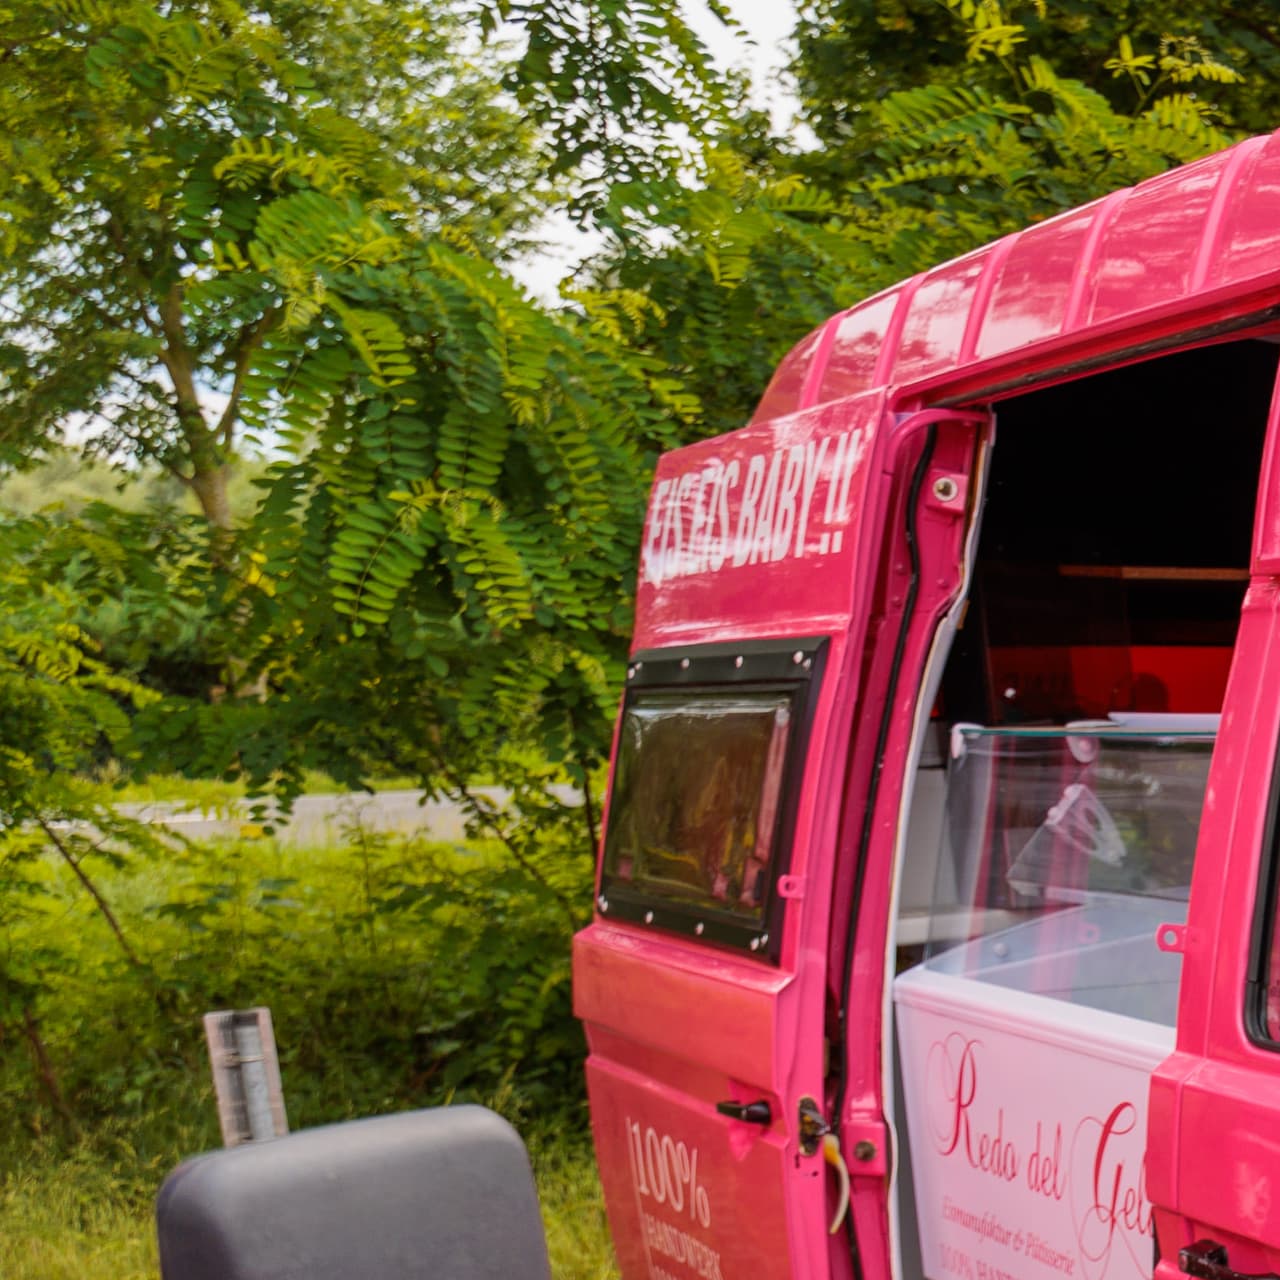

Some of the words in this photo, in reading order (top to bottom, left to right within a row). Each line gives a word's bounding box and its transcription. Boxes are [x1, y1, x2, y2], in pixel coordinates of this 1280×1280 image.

[736, 440, 829, 567] BABY
[631, 1122, 710, 1228] 100%
[926, 1032, 1018, 1182] Redo
[1027, 1121, 1070, 1200] del
